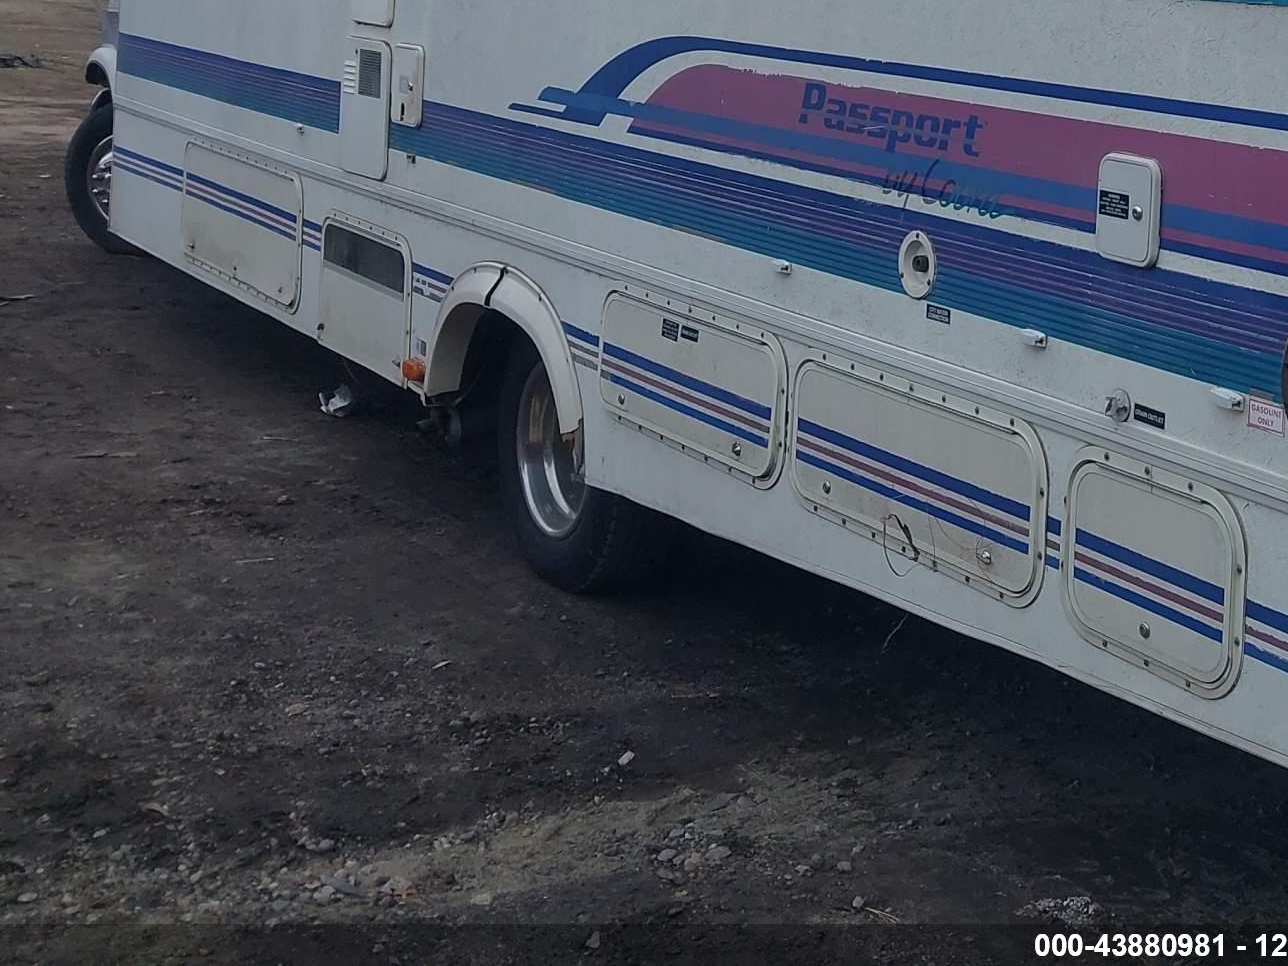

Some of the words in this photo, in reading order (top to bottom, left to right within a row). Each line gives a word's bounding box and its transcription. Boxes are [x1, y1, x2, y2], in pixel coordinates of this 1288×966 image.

[798, 81, 983, 158] Passport
[1251, 403, 1282, 419] GASOLINE
[1257, 416, 1274, 427] ONLY
